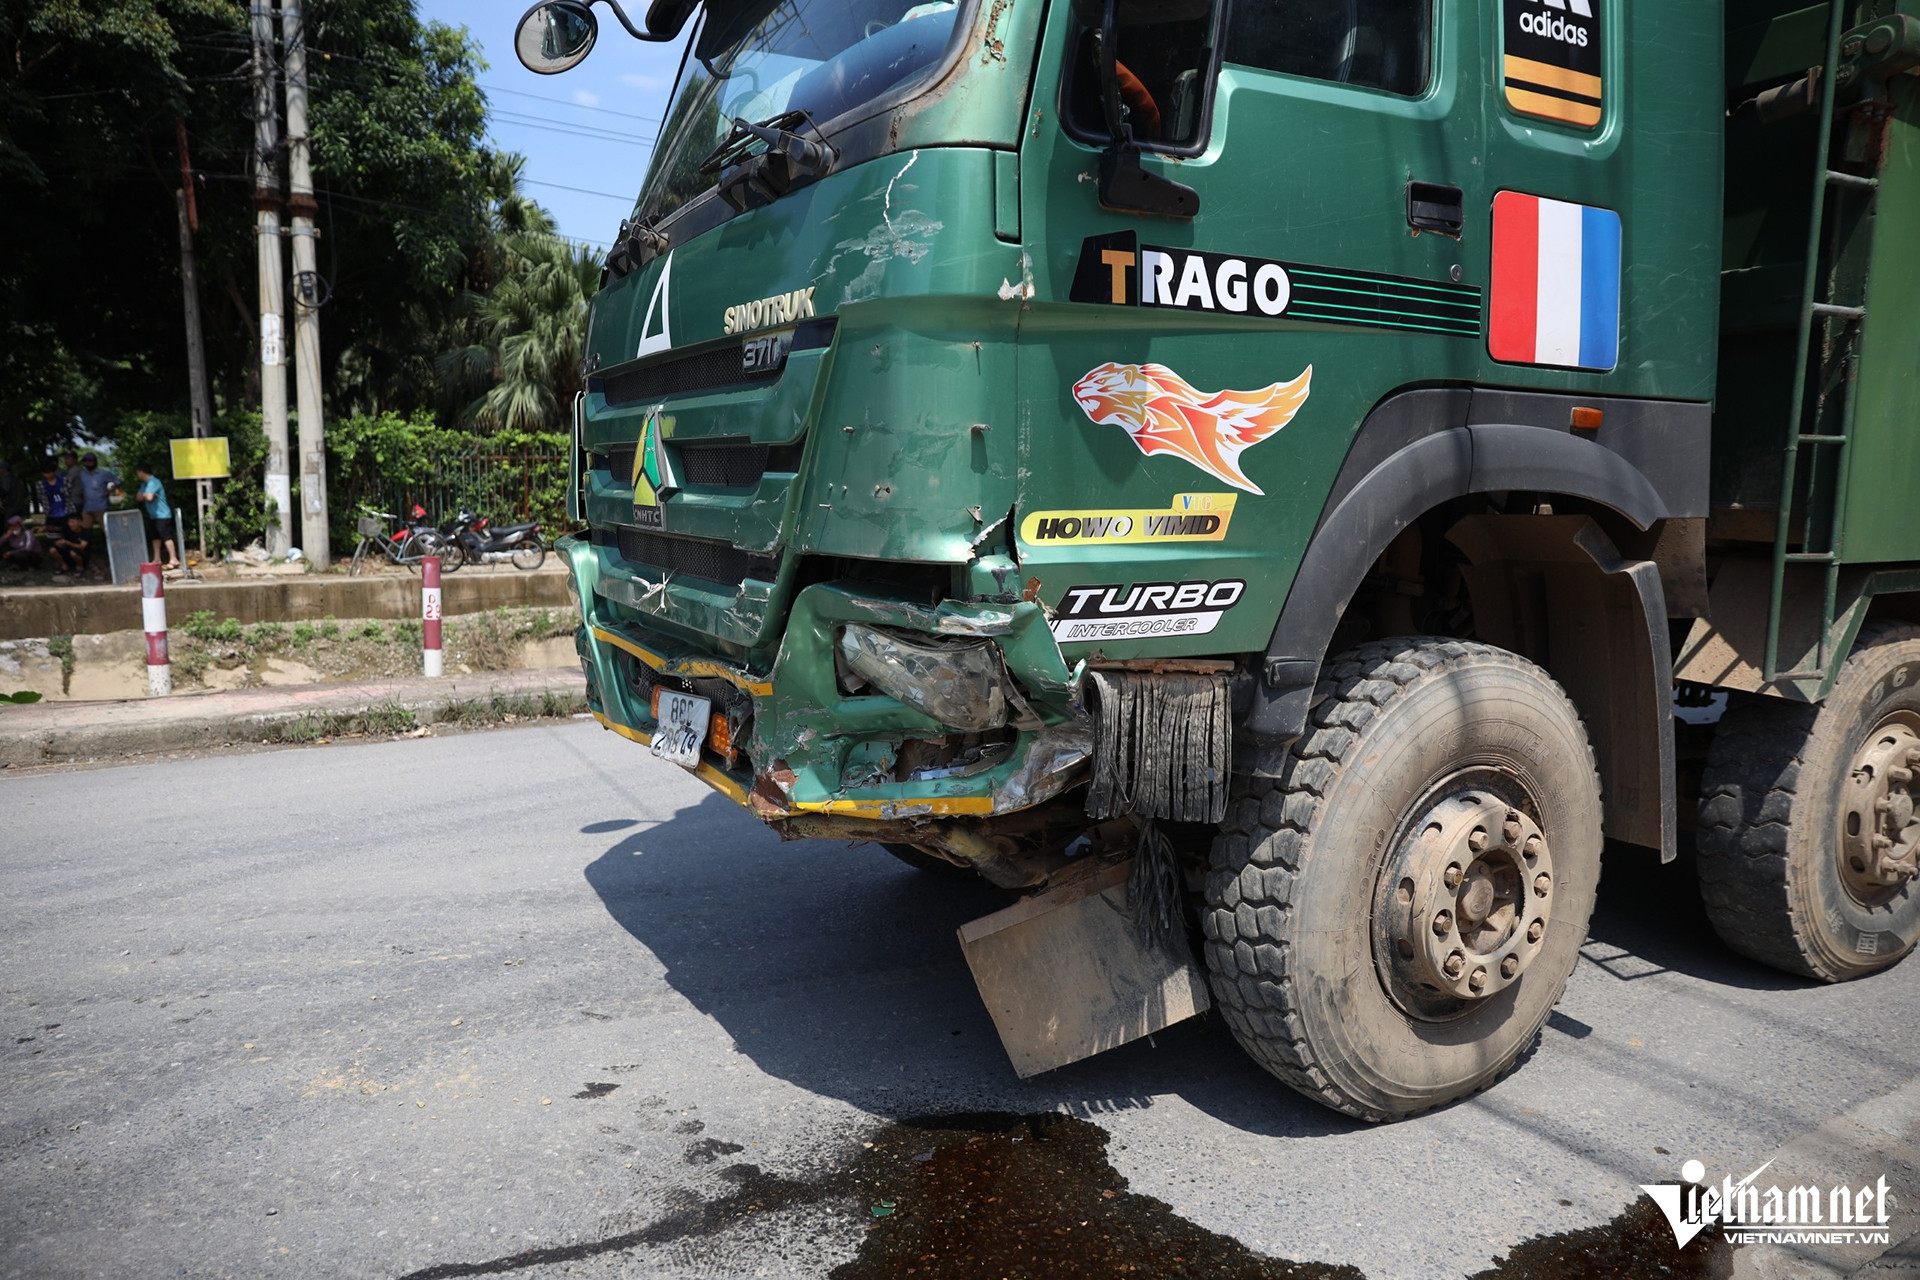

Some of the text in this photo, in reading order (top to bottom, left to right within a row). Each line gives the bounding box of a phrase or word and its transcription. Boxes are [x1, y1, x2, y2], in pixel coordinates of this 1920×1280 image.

[1519, 11, 1588, 47] adidas
[724, 286, 815, 335] SINOTRUK
[1036, 515, 1220, 540] HOWO VIMID
[1068, 582, 1243, 614] TURBO
[1067, 618, 1198, 637] INTERCOOLER
